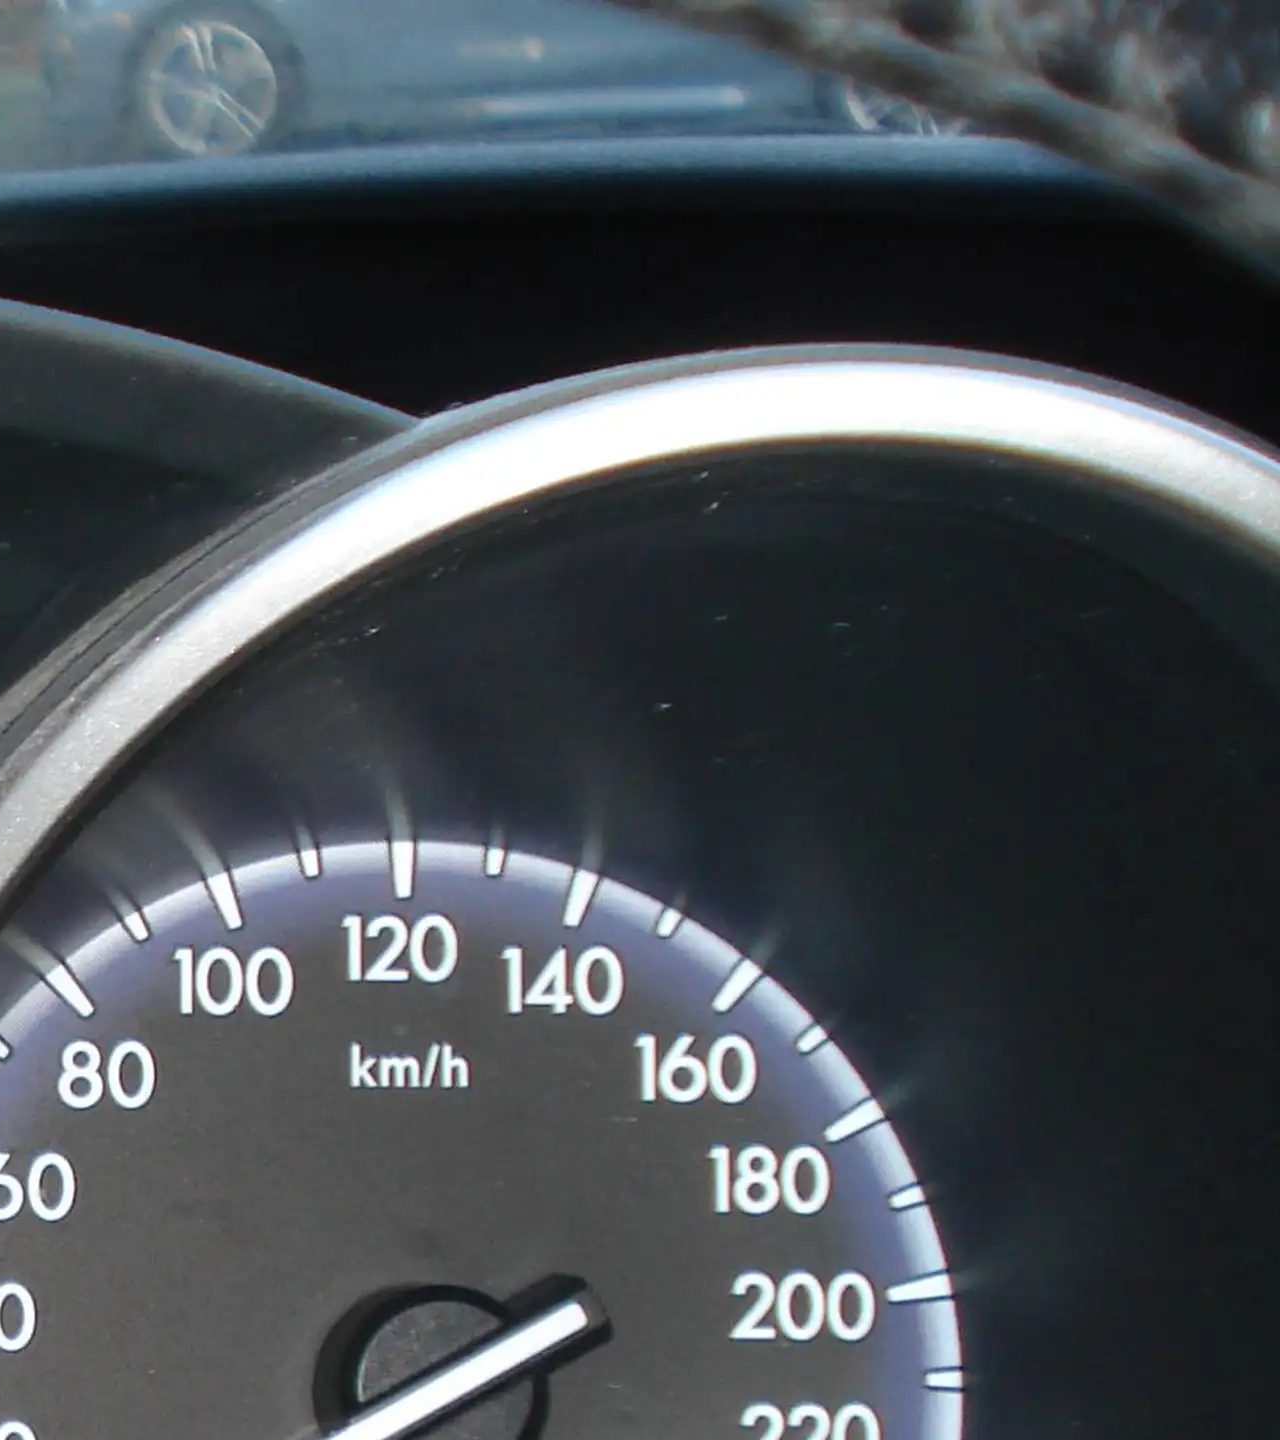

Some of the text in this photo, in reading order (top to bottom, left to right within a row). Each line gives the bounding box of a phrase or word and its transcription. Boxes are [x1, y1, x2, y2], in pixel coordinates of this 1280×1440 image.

[173, 946, 294, 1016] 100
[341, 914, 458, 982] 120
[501, 945, 623, 1015] 140
[57, 1040, 155, 1109] 80
[350, 1043, 469, 1088] km/h
[634, 1034, 756, 1103] 160
[708, 1145, 830, 1214] 180
[729, 1271, 875, 1341] 200
